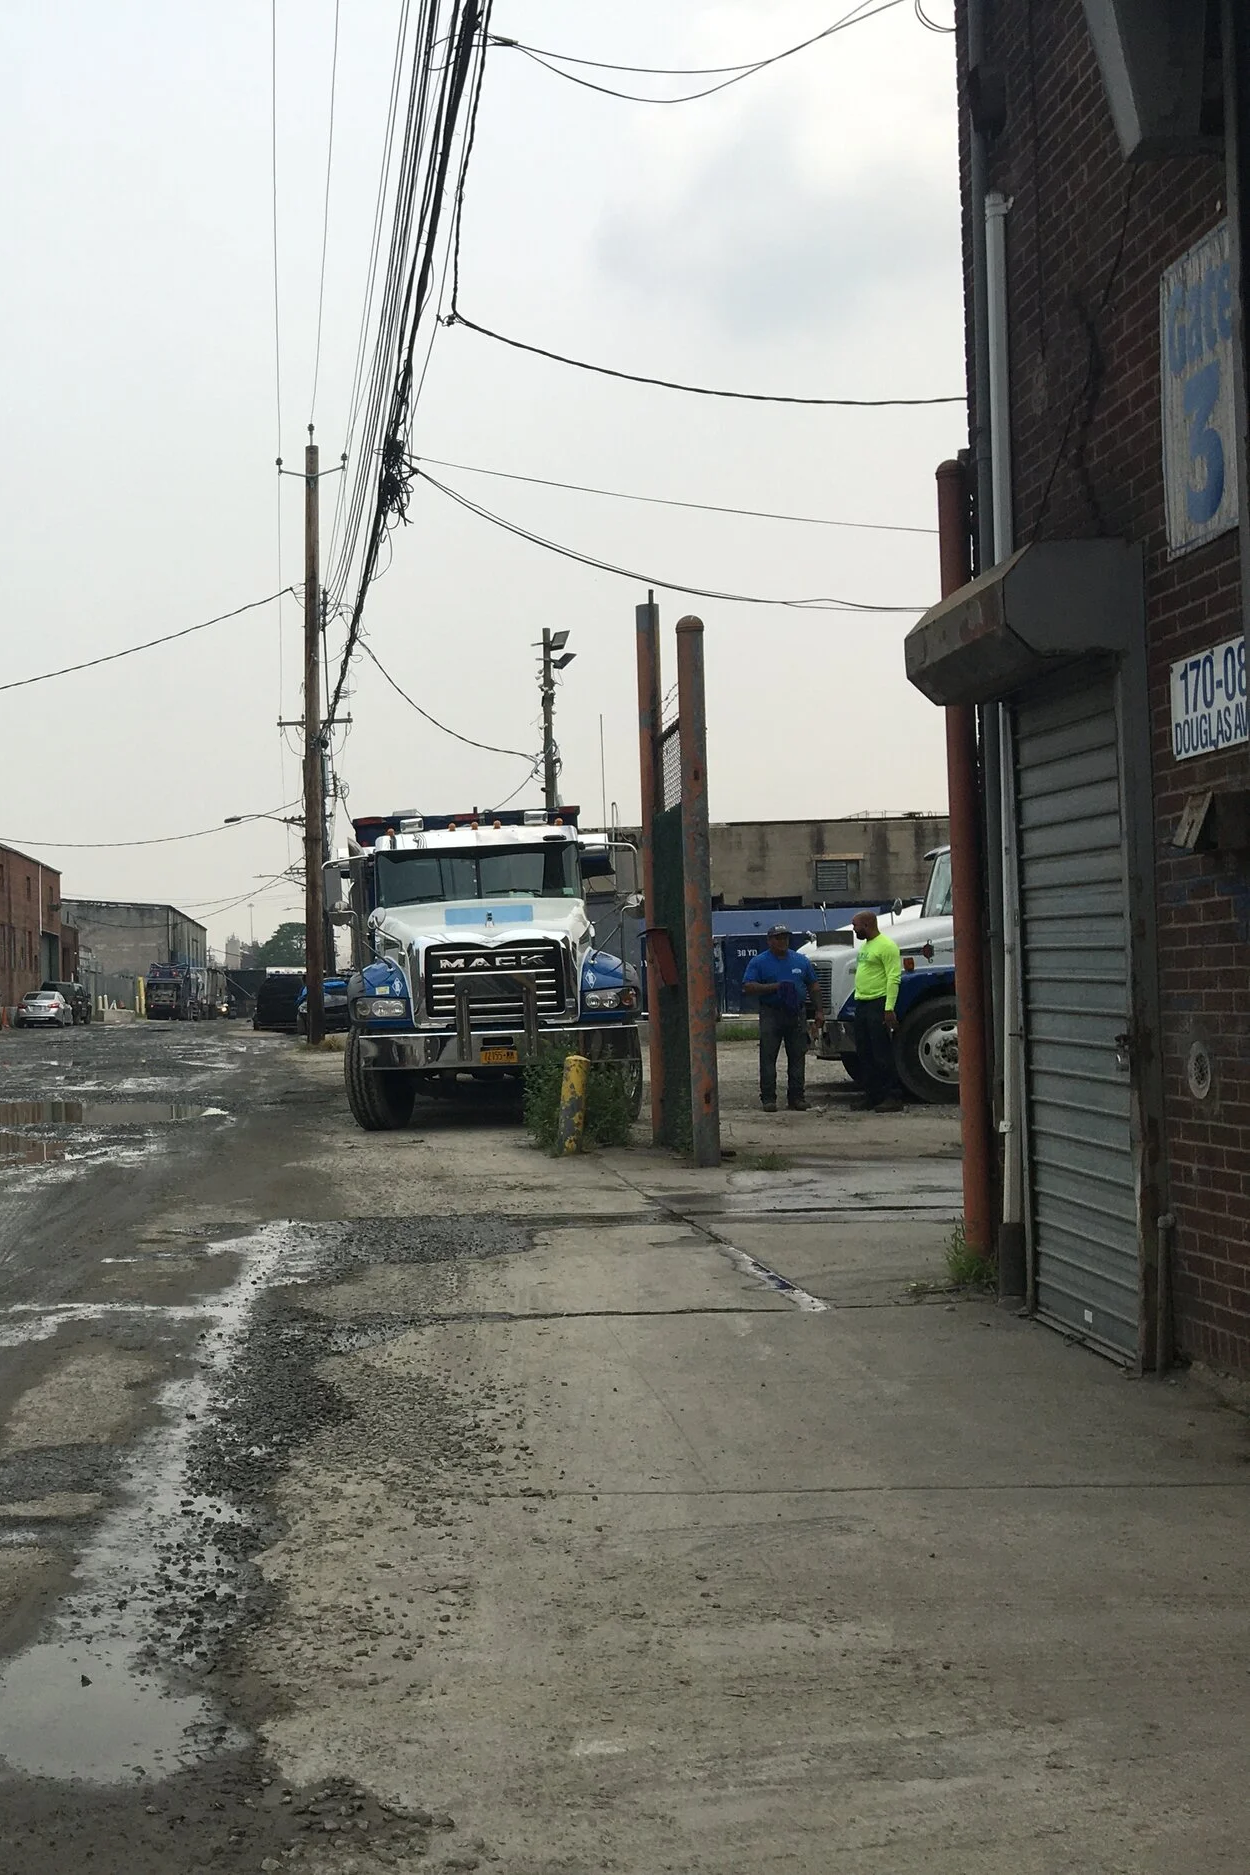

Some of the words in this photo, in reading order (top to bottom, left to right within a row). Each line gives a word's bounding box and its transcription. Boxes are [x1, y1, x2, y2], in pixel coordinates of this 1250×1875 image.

[1183, 358, 1225, 524] 3
[1179, 641, 1247, 716] 170-08
[1174, 706, 1232, 756] DOUGLAS
[439, 954, 546, 969] MACK
